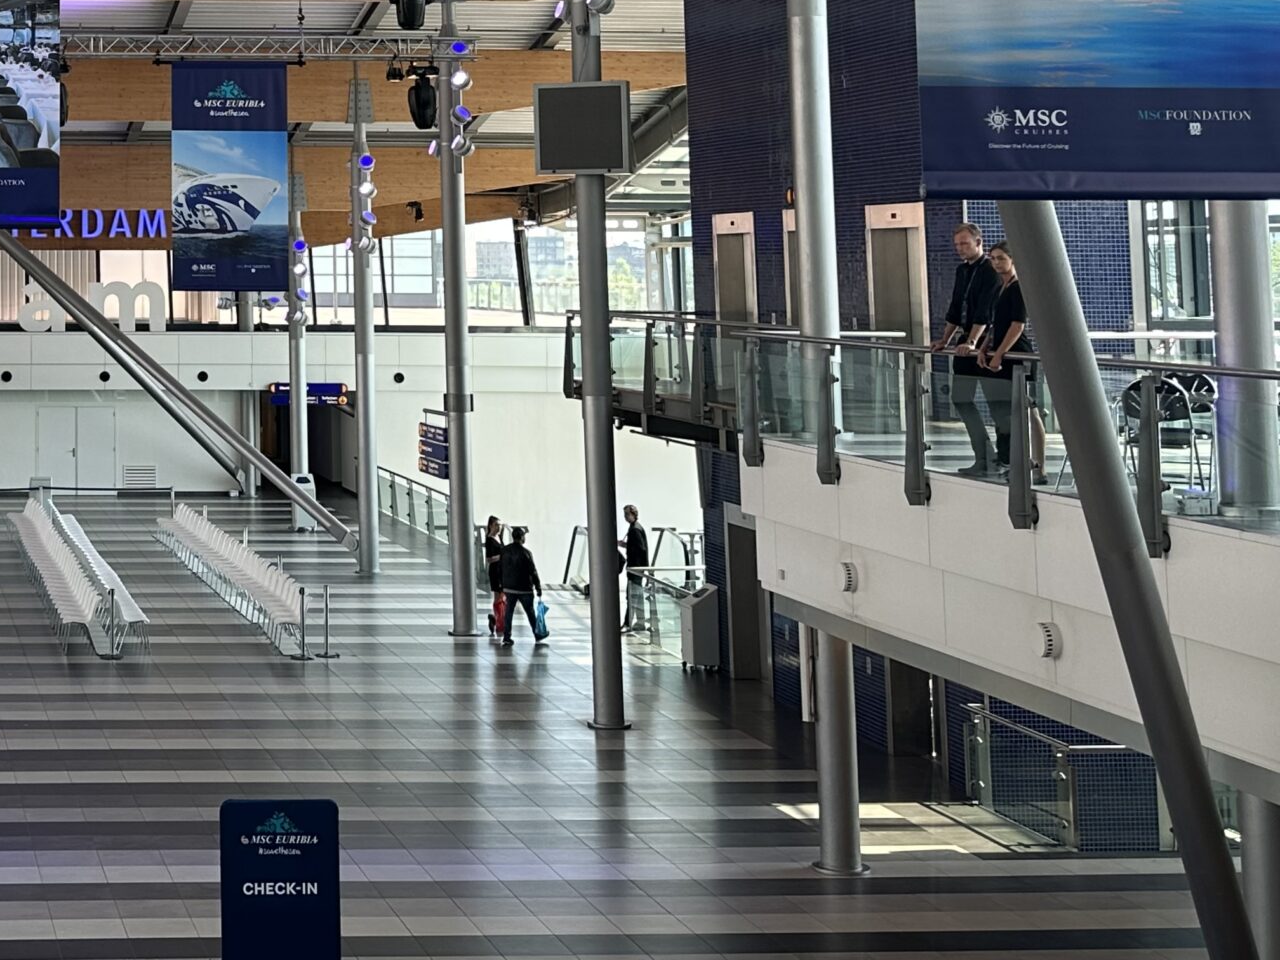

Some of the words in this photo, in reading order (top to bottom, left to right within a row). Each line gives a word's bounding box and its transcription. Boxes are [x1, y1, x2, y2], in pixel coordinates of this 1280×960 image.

[203, 100, 224, 108] MSC
[225, 100, 266, 108] EURIBIA
[1014, 109, 1068, 126] MSC
[251, 835, 274, 844] MSC
[275, 835, 319, 844] EURIBIA
[242, 882, 318, 895] CHECK-IN
